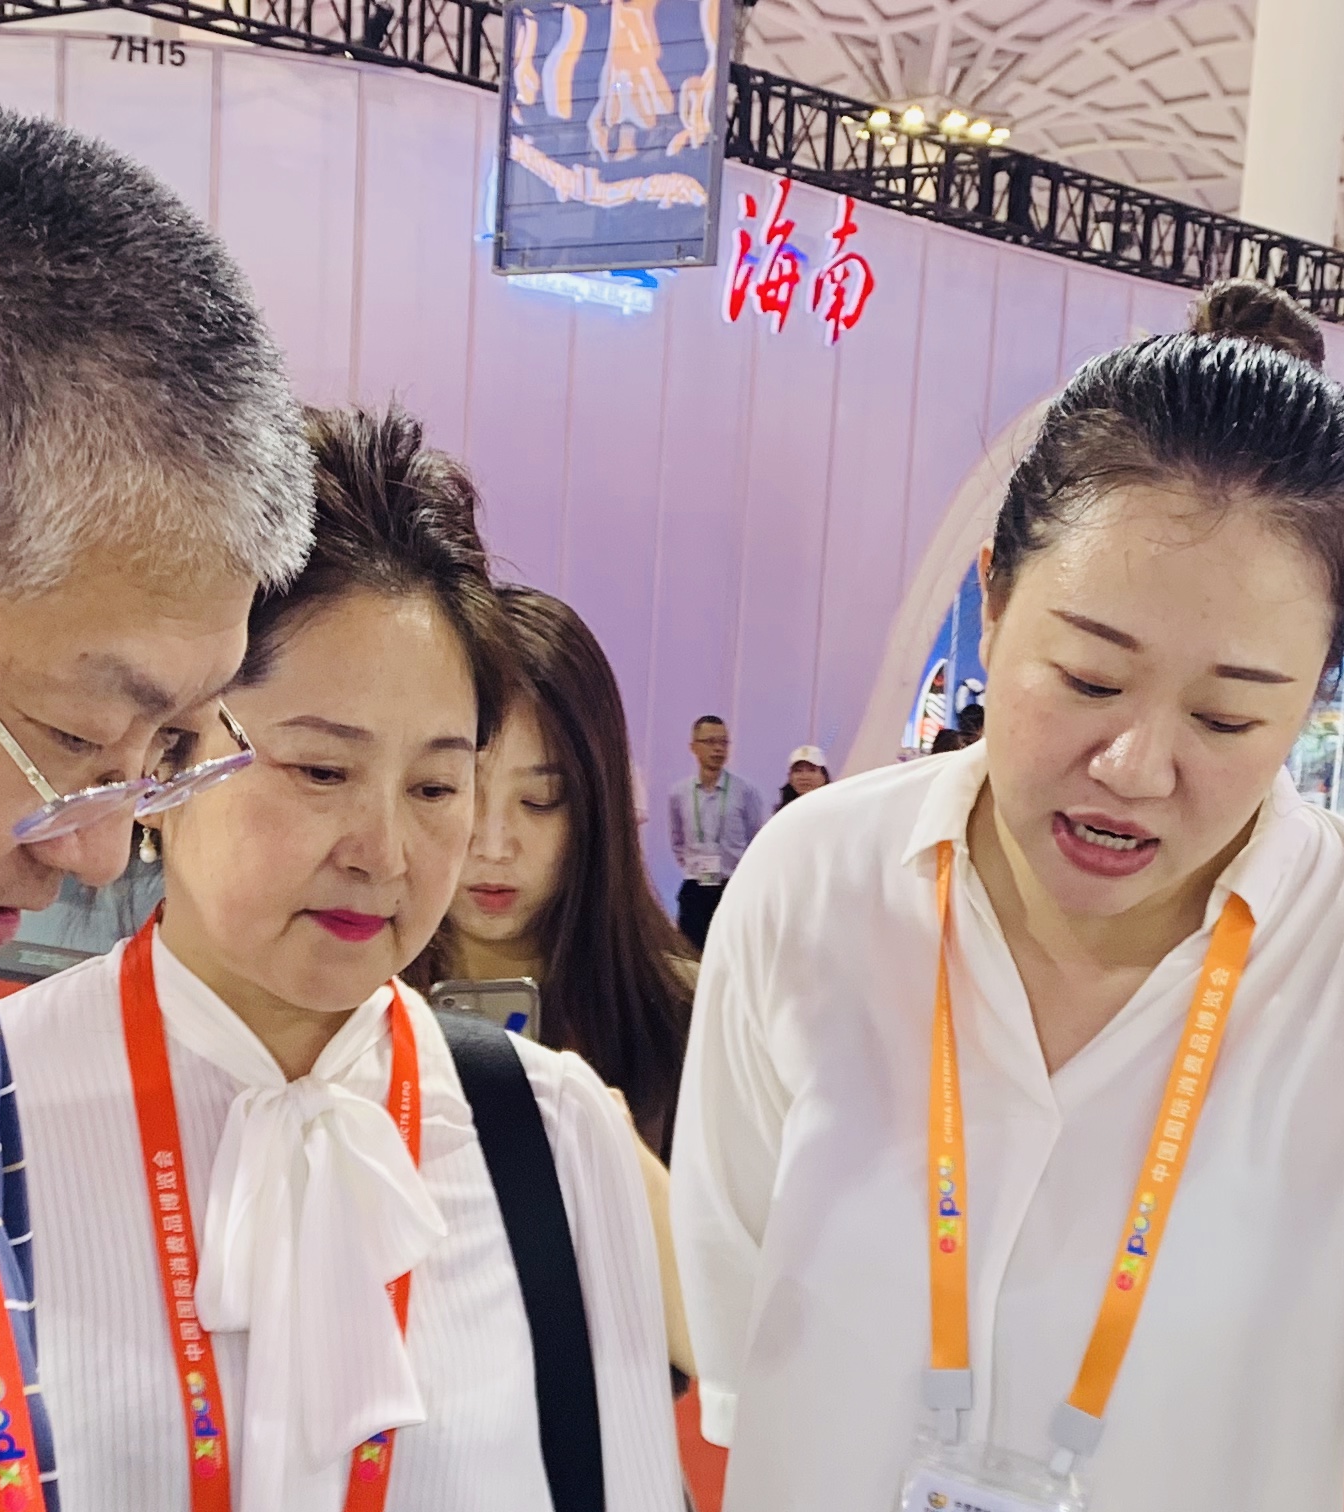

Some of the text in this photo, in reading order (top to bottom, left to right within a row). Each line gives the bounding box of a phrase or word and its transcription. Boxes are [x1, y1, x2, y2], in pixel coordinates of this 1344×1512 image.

[107, 34, 186, 67] 7H15
[722, 178, 874, 347] 海南
[1150, 968, 1230, 1183] 中国国际消费品博览会
[153, 1149, 206, 1363] 中国国际消费品博览会
